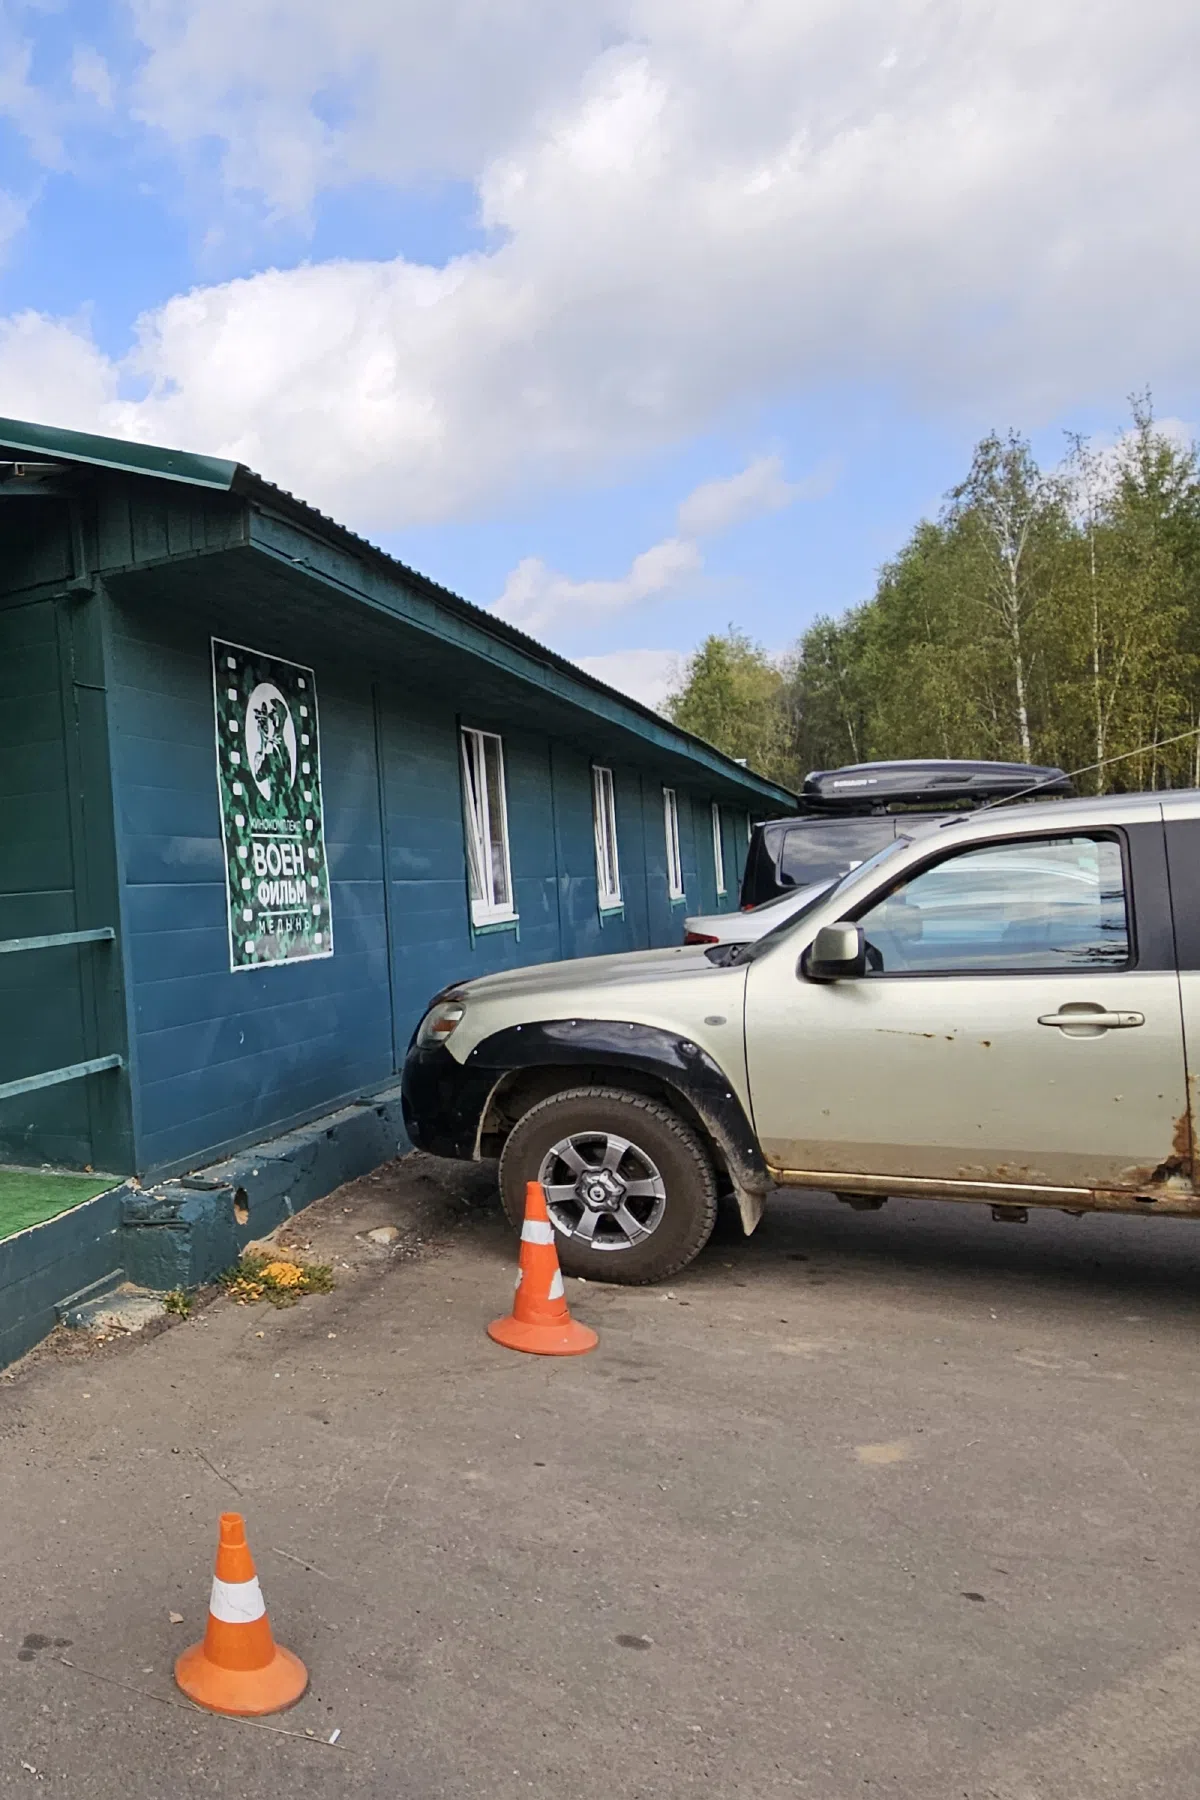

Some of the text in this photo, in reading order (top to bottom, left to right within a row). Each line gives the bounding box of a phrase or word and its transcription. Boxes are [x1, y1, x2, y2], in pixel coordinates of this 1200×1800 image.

[253, 843, 305, 876] ВОЕН
[258, 880, 306, 906] ФИЛЬМ
[258, 917, 311, 934] МЕДЫНЬ
